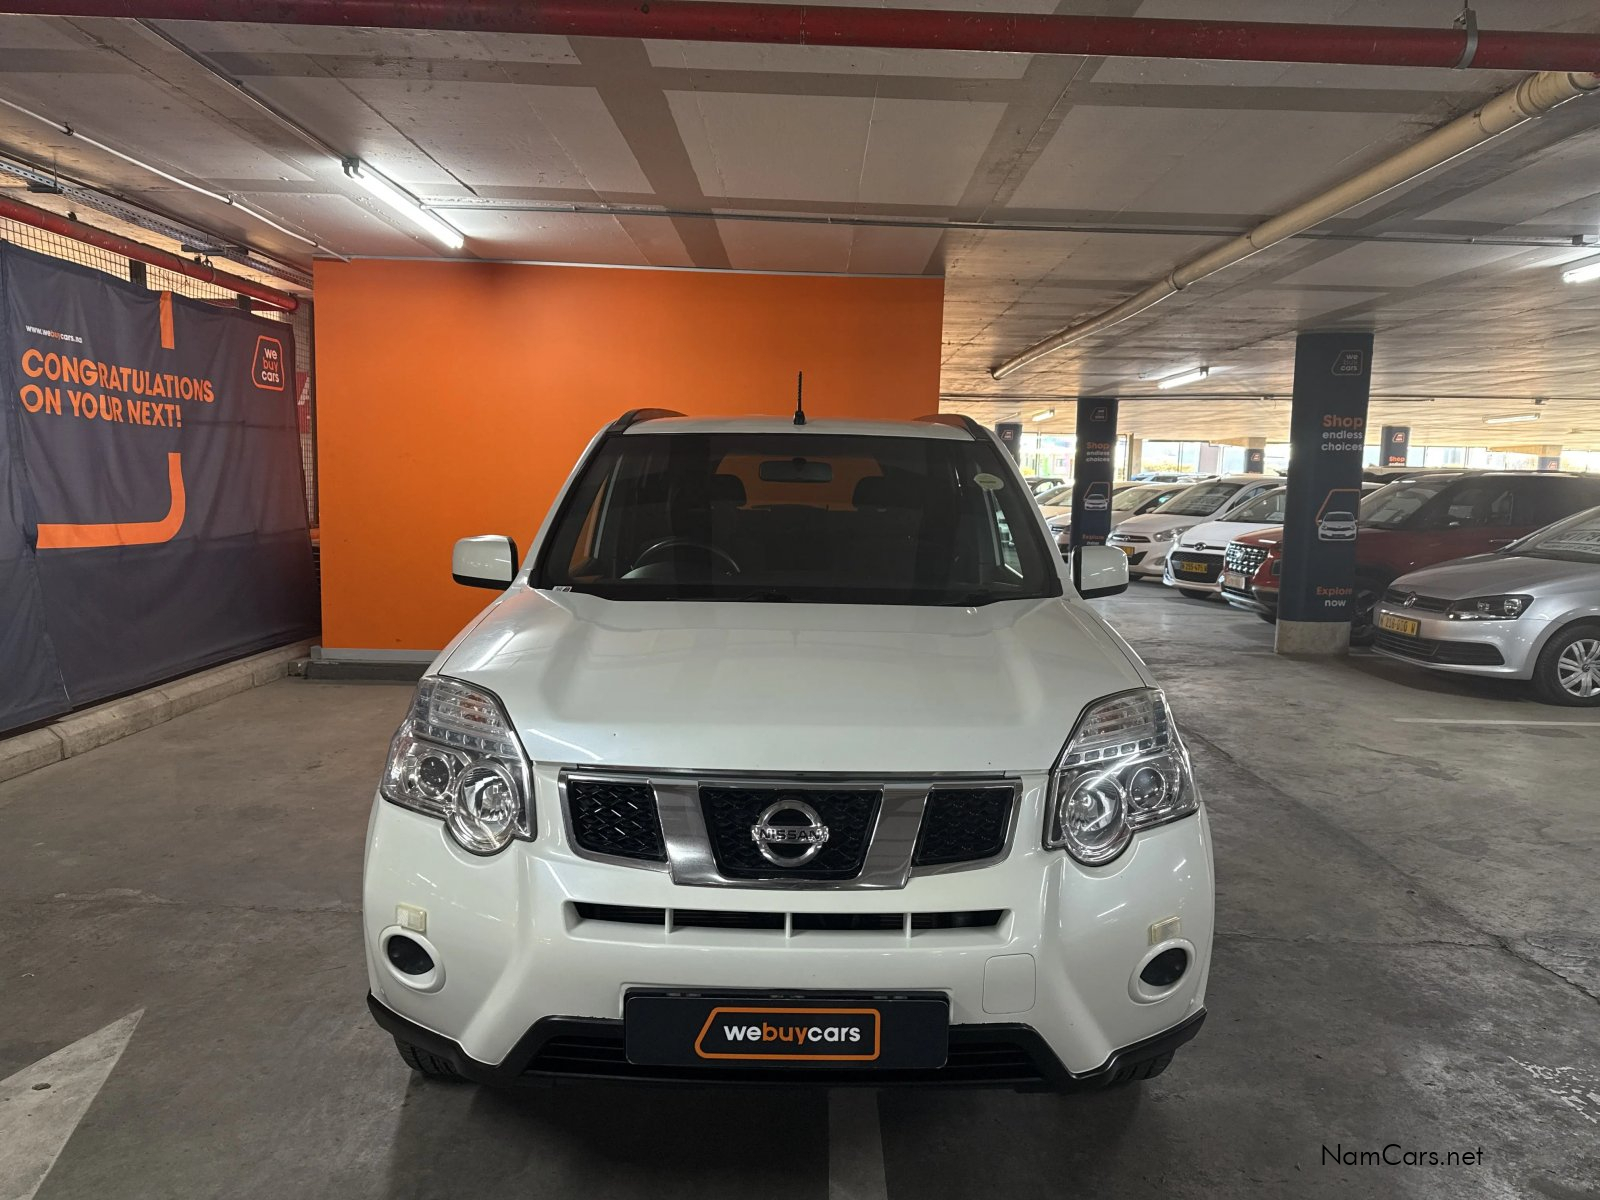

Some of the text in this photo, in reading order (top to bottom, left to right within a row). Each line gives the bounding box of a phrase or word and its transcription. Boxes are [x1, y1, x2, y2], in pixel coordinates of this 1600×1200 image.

[264, 348, 278, 360] we
[262, 356, 279, 372] buy
[21, 348, 215, 403] CONGRATULATIONS
[261, 370, 280, 383] cars
[20, 384, 182, 428] ON YOUR NEXT!
[1323, 414, 1363, 430] Shop
[1322, 430, 1363, 439] endless
[1321, 442, 1363, 451] choices
[760, 828, 820, 840] NISSAN
[723, 1022, 861, 1045] webuycars
